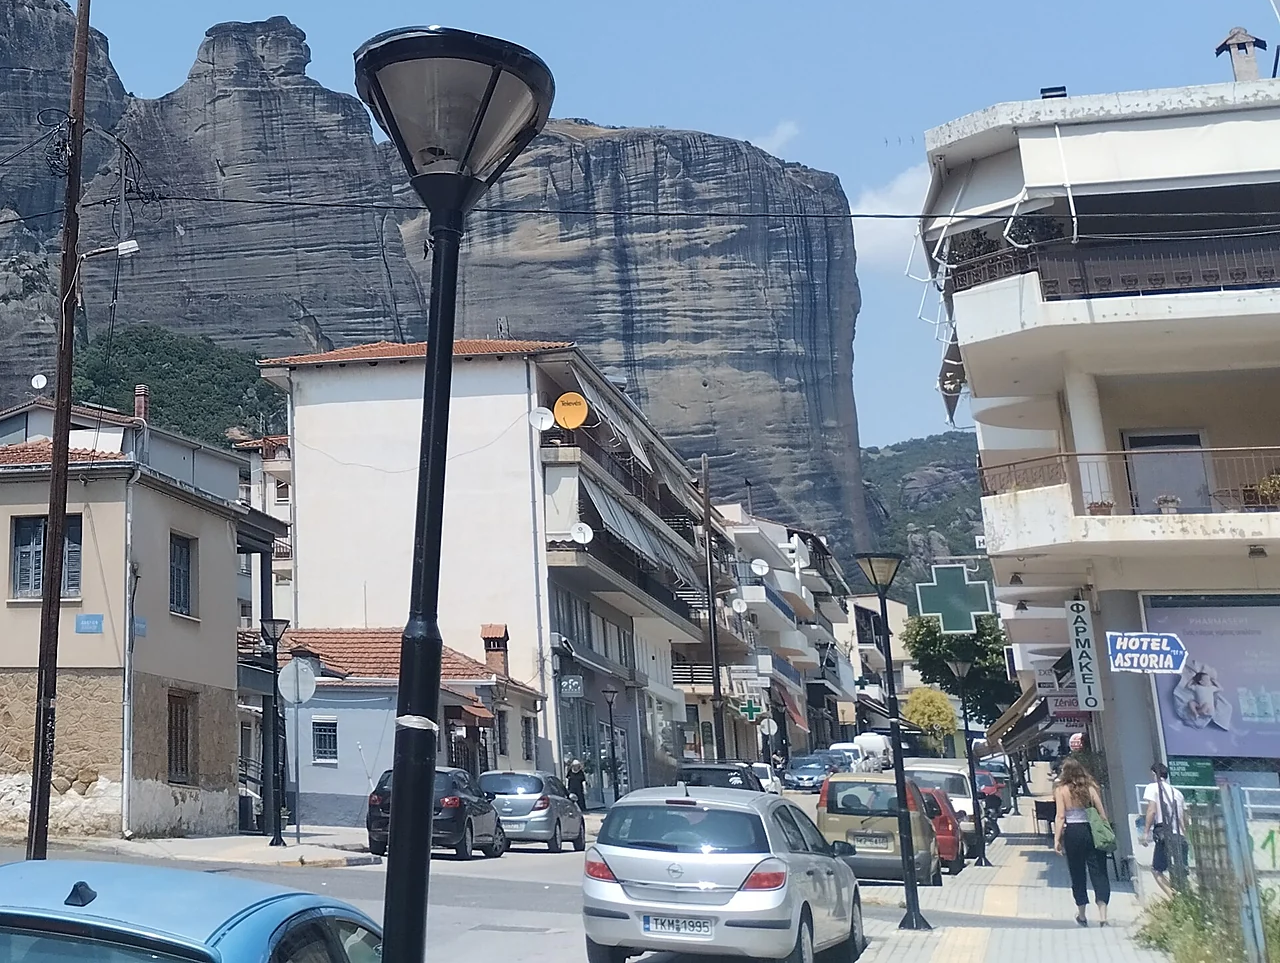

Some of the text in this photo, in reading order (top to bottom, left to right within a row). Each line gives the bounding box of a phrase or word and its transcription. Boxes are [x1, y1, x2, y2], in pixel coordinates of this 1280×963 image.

[1115, 637, 1171, 651] HOTEL
[1069, 602, 1099, 708] ΦΑΡΜΑΚΕΙΟ
[1114, 652, 1174, 669] ASTORIA
